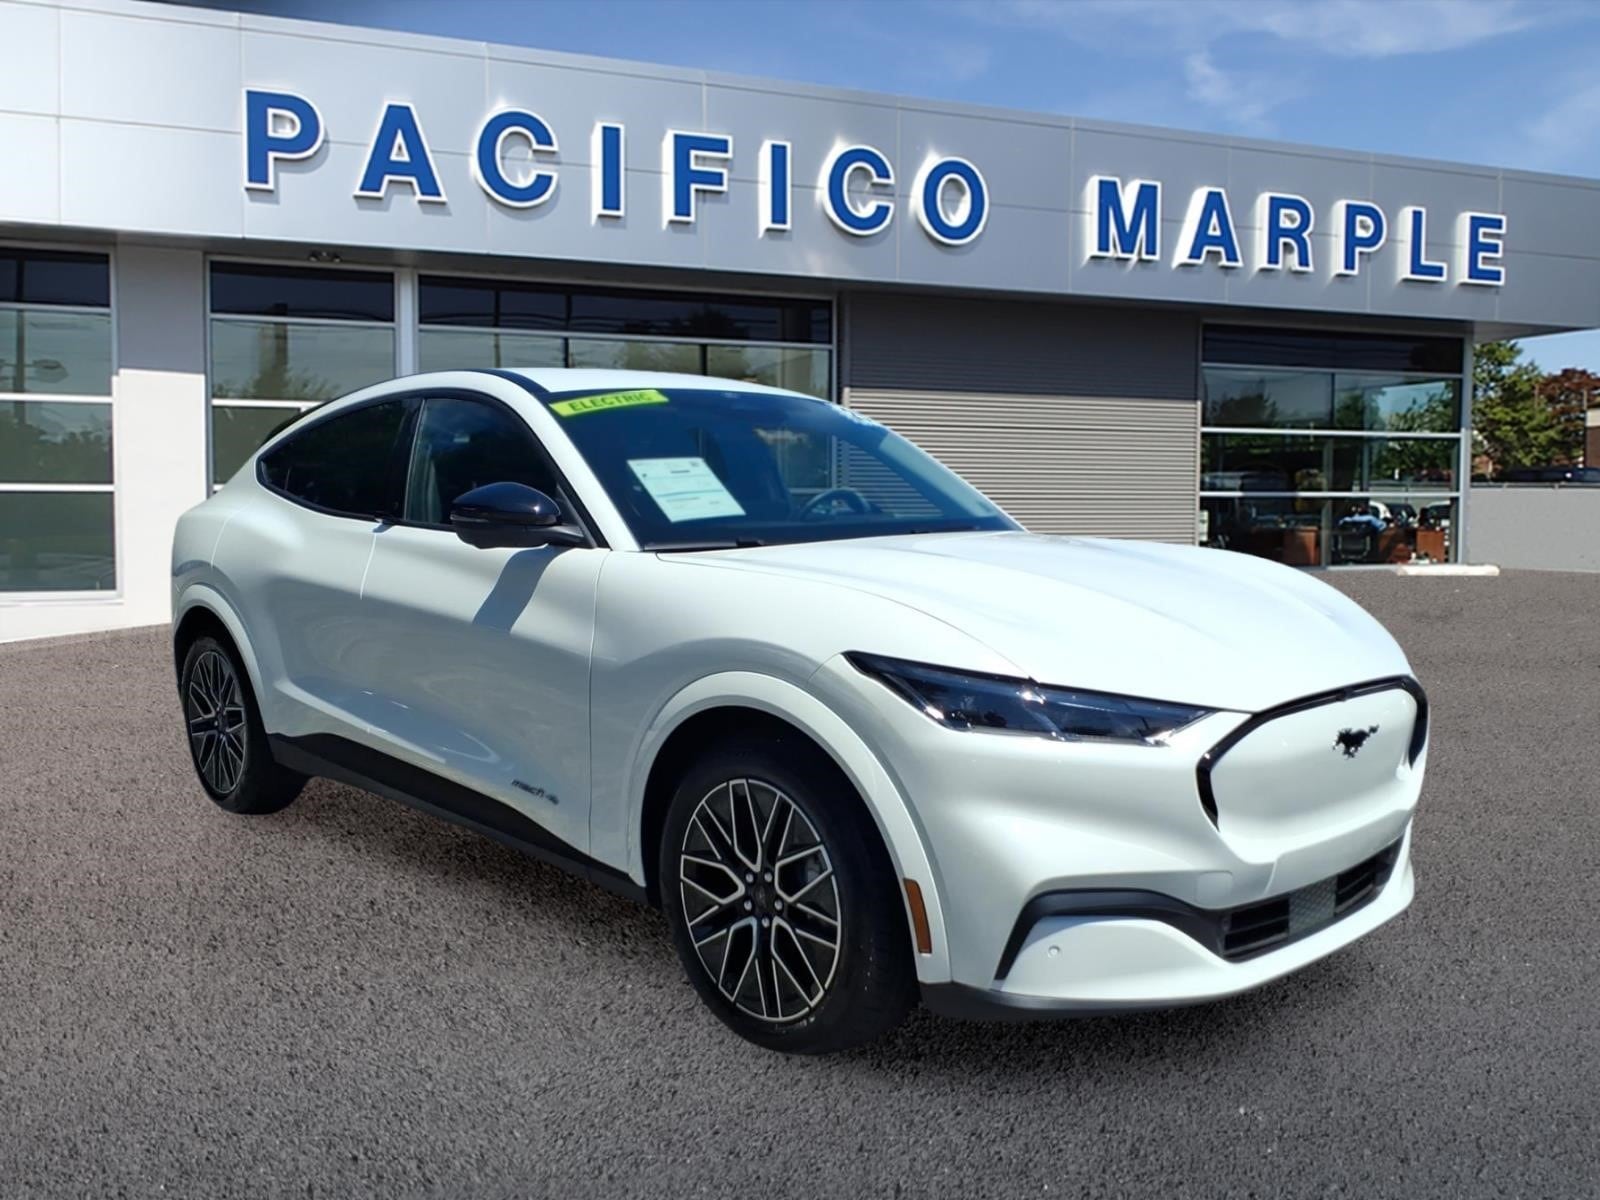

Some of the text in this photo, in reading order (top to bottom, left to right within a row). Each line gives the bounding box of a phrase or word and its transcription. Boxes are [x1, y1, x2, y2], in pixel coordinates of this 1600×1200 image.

[243, 88, 1507, 287] PACIFICO MARPLE
[567, 391, 654, 412] ELECTRIC
